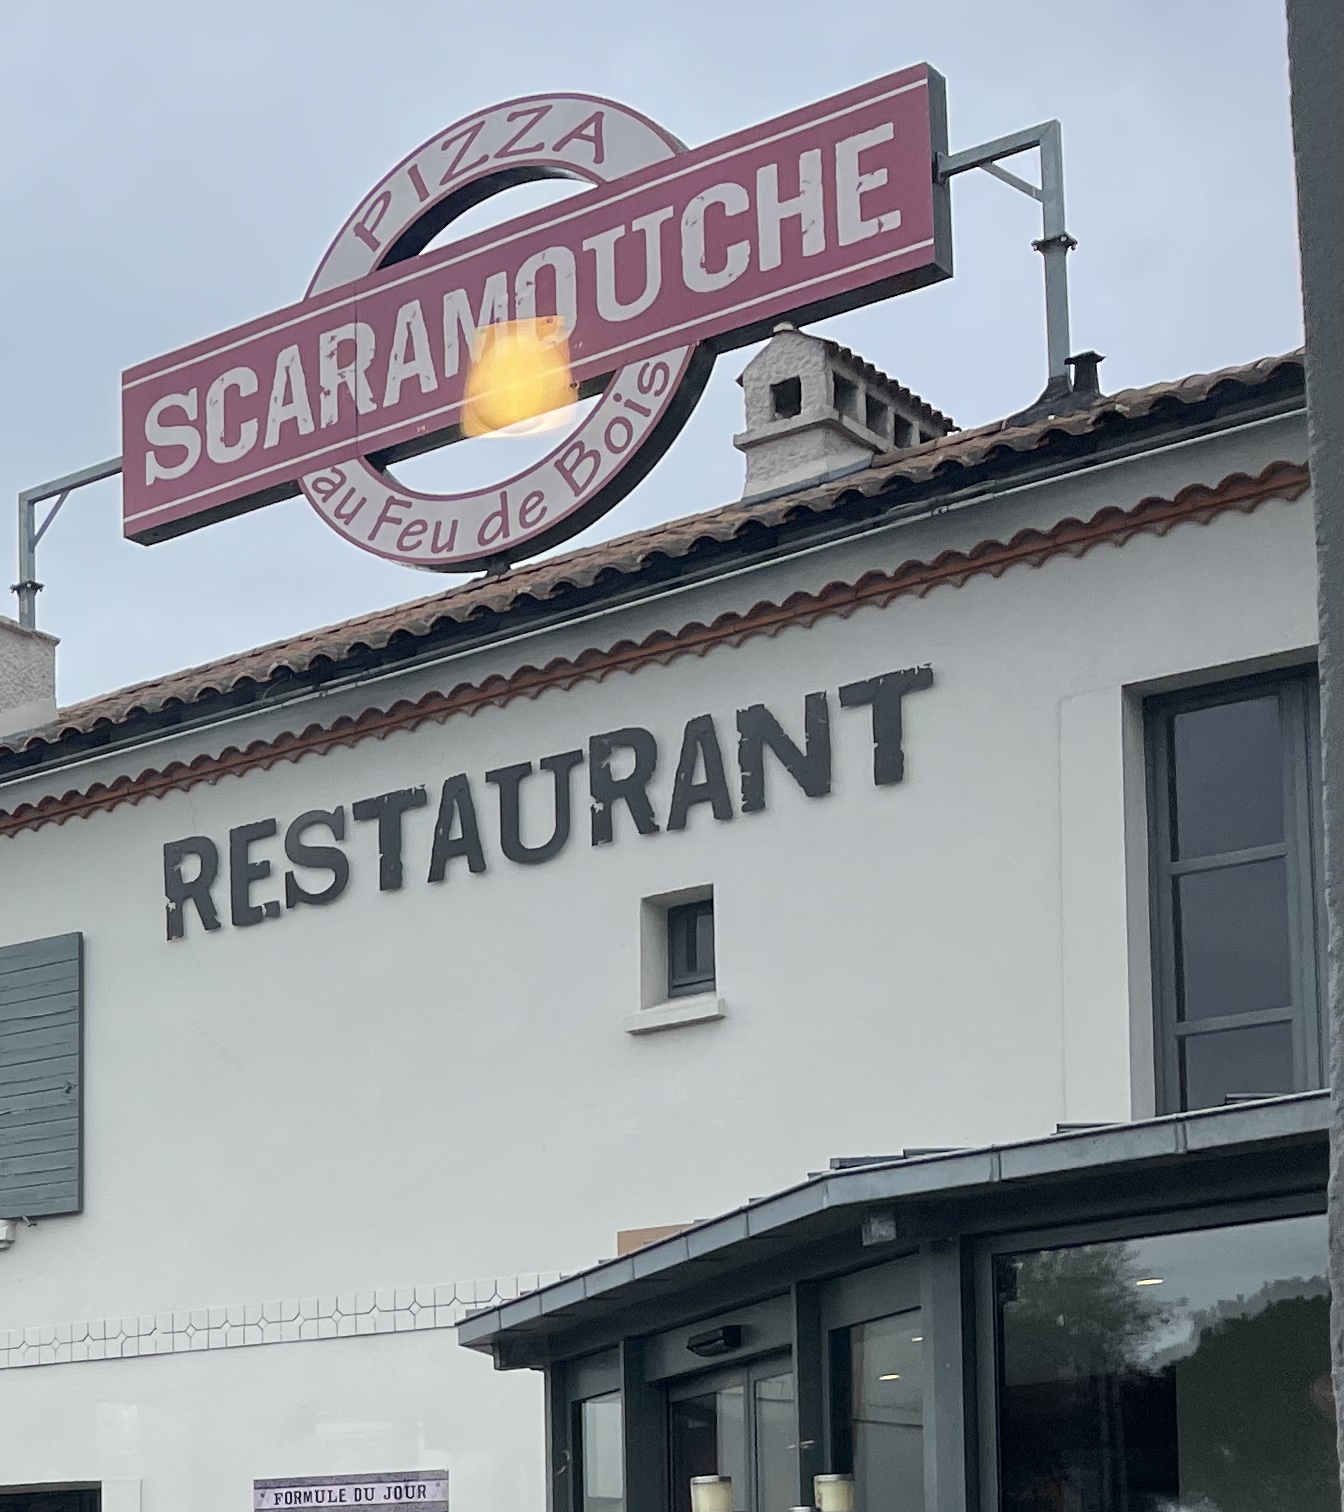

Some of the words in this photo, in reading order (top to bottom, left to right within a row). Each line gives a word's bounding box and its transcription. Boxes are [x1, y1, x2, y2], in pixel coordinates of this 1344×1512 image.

[354, 102, 606, 254] PIZZA
[143, 121, 904, 487] SCARAMOUCHE
[312, 465, 367, 524] au
[367, 501, 461, 555] Feu
[477, 489, 549, 547] de
[554, 360, 672, 499] Bois
[164, 662, 934, 942] RESTAURANT
[274, 1488, 347, 1506] FORMULE
[354, 1486, 376, 1502] DU
[384, 1484, 427, 1501] JOUR
